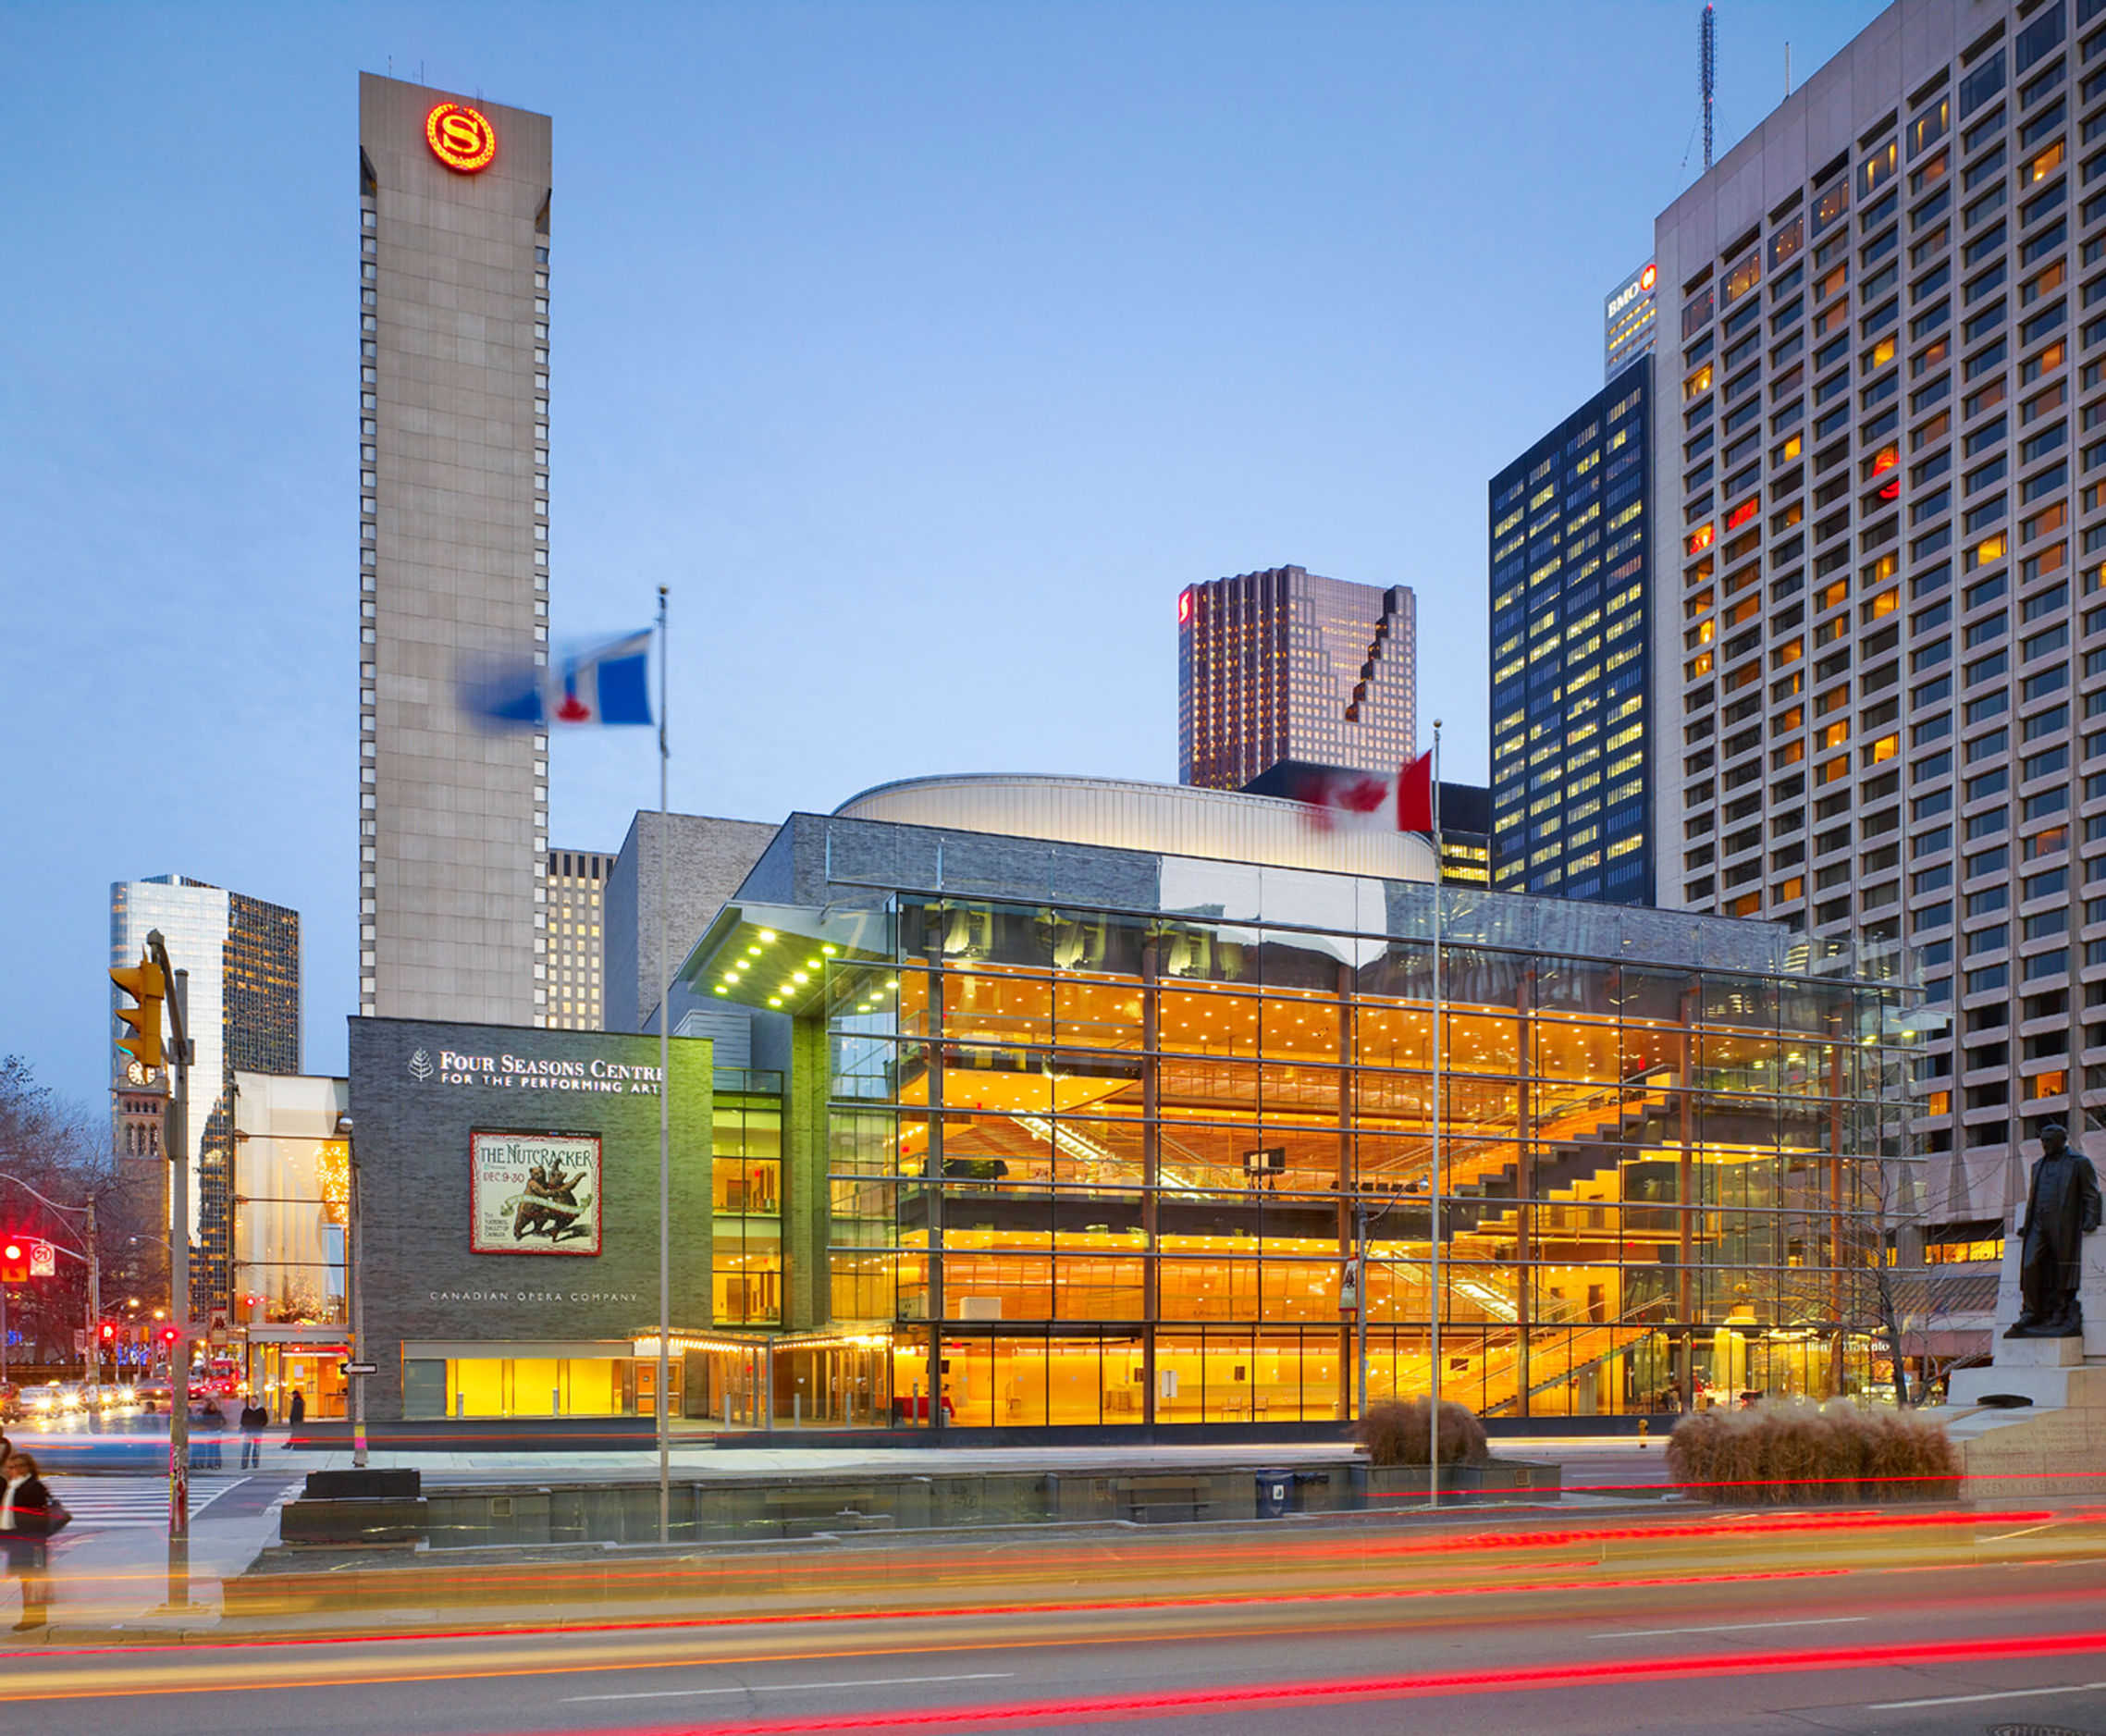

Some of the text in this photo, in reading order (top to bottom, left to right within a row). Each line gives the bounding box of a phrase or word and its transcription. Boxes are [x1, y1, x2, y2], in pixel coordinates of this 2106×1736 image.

[1608, 281, 1640, 318] BMO
[441, 1073, 664, 1095] FOR THE PERFORMING ART
[481, 1143, 594, 1169] THE NUTCRACKER
[483, 1172, 525, 1184] DEC 9-30
[430, 1291, 637, 1303] CANADIAN OPERA COMPANY
